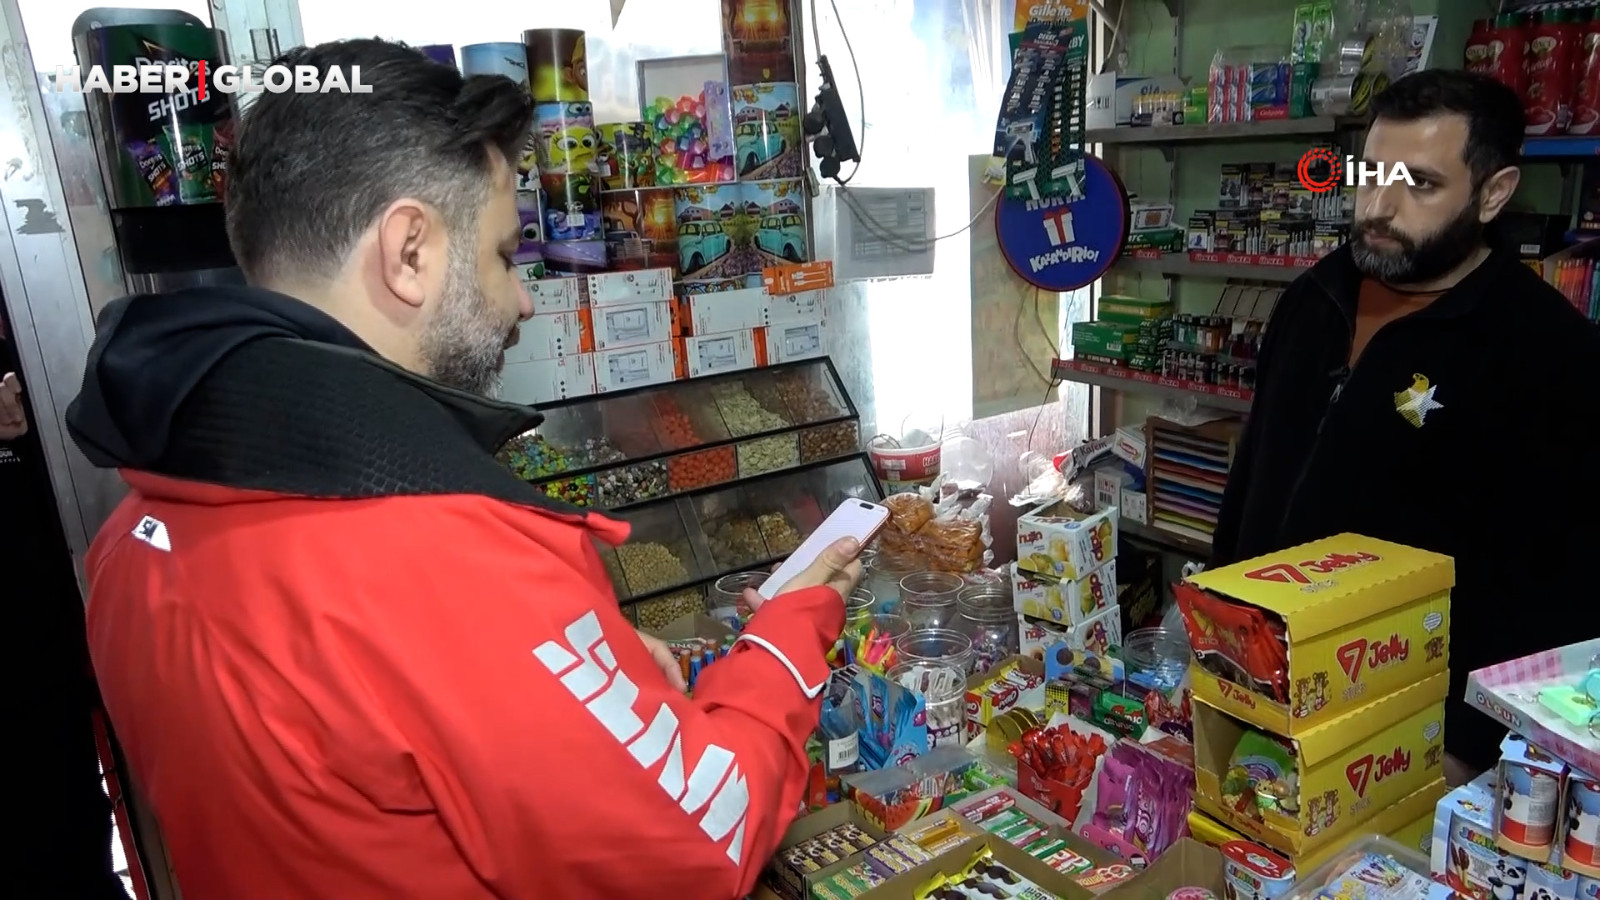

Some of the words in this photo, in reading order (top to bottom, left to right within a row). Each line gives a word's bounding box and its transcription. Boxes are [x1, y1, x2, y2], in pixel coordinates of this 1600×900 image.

[1029, 4, 1072, 17] Gillette
[1079, 439, 1108, 457] Kafem
[1299, 552, 1381, 573] Jelly
[1368, 632, 1410, 670] Jelly
[1232, 689, 1256, 710] Jelly
[1374, 746, 1411, 783] Jelly
